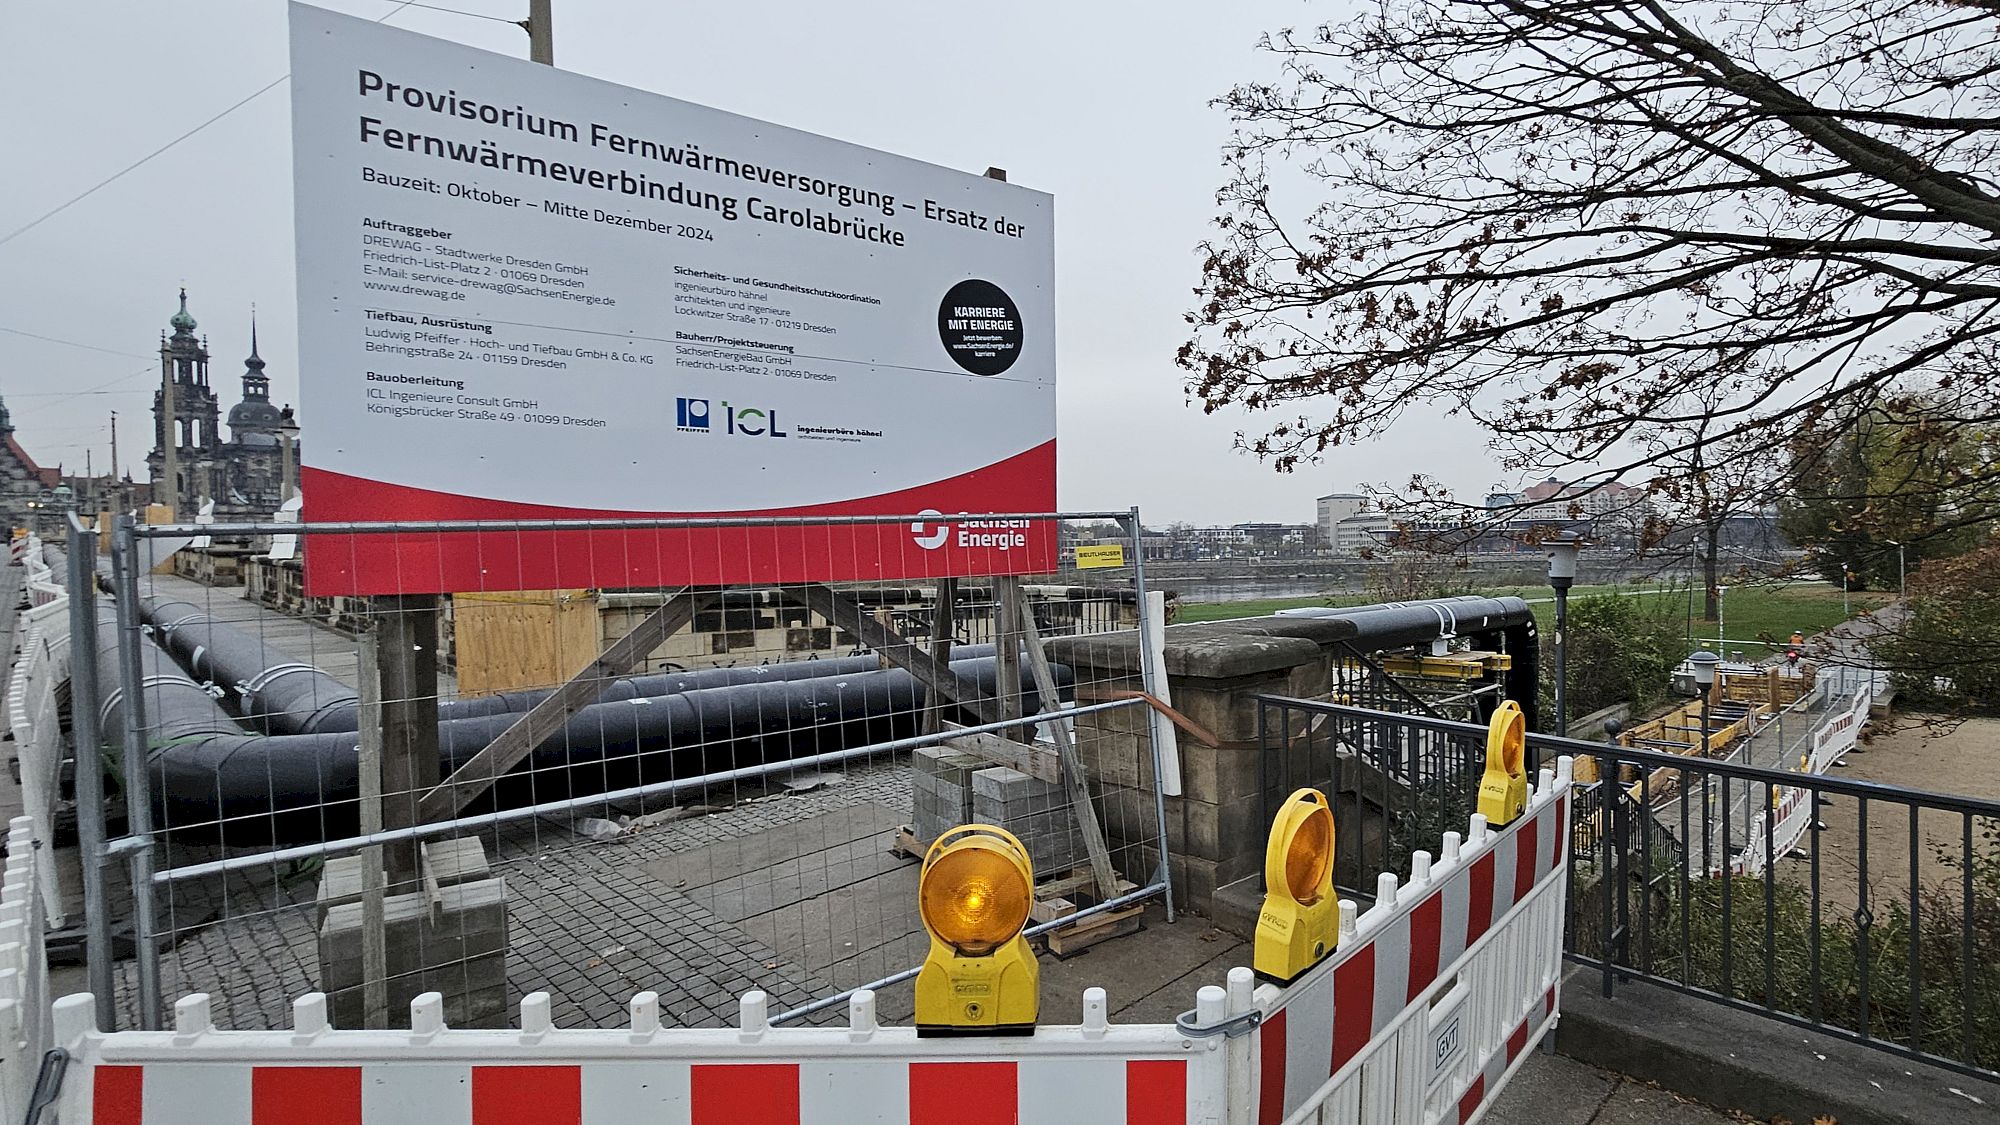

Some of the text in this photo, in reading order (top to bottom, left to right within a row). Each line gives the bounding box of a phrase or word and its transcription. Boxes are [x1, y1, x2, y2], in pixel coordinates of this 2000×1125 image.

[359, 69, 578, 143] Provisorium
[590, 123, 895, 217] Fernwärmeversorgung
[924, 199, 988, 232] Ersatz
[994, 215, 1025, 239] der
[360, 115, 905, 247] Fernwärmeverbindung Carolabrücke
[362, 166, 441, 194] Bauzeit:
[447, 182, 521, 208] Oktober
[544, 199, 589, 220] Mitte
[594, 208, 673, 235] Dezember
[676, 224, 714, 242] 2024
[362, 217, 452, 240] Auftraggeber
[363, 234, 423, 253] DREWAG
[434, 244, 503, 265] Stadtwerke
[505, 255, 553, 272] Dresden
[554, 262, 589, 276] GmbH
[363, 249, 481, 275] Friedrich-List-Platz
[483, 266, 492, 277] 2
[500, 268, 538, 283] 01069
[539, 273, 585, 289] Dresden
[363, 264, 616, 307] E-Mail: service-drewag@SachsenEnergie.de
[363, 281, 466, 302] www.drewag.de
[673, 265, 881, 305] Sicherheits- und Gesundheitsschutzkoordination
[674, 282, 737, 298] ingenieurbüro
[674, 293, 791, 317] architekten und ingenieure
[954, 306, 1006, 318] KARRIERE
[363, 309, 493, 335] Tiefbau, Ausrüstung
[674, 305, 725, 320] Lockwitzer
[726, 312, 757, 325] Straße
[758, 317, 769, 326] 17
[775, 319, 802, 330] 01219
[802, 322, 837, 334] Dresden
[948, 319, 1014, 331] MIT ENERGIE
[365, 326, 411, 345] Ludwig
[414, 332, 460, 347] Pfeiffer
[469, 337, 506, 349] Hoch-
[508, 343, 530, 353] und
[531, 343, 573, 357] Tiefbau
[575, 348, 608, 360] GmbH
[610, 351, 620, 361] &
[621, 352, 638, 363] Co.
[639, 354, 654, 365] KG
[365, 341, 455, 360] Behringstraße
[457, 350, 474, 361] 24
[482, 352, 518, 365] 01159
[521, 355, 567, 369] Dresden
[675, 330, 795, 355] Bauherr/Projektsteuerung
[675, 345, 792, 366] SachsenEnergieBau GmbH
[366, 371, 465, 391] Bauoberleitung
[675, 357, 762, 375] Friedrich-List-Platz
[762, 366, 769, 376] 2
[774, 368, 803, 379] 01069
[803, 370, 837, 382] Dresden
[367, 388, 538, 410] ICL Ingenieure Consult GmbH
[367, 403, 456, 418] Königsbrücker
[457, 408, 497, 421] Straße
[499, 411, 515, 422] 49
[522, 410, 560, 425] 01099
[562, 415, 606, 428] Dresden
[797, 424, 883, 437] ingenieurbüro hähnel
[958, 530, 1025, 550] Energie
[1437, 1026, 1458, 1059] GVT
